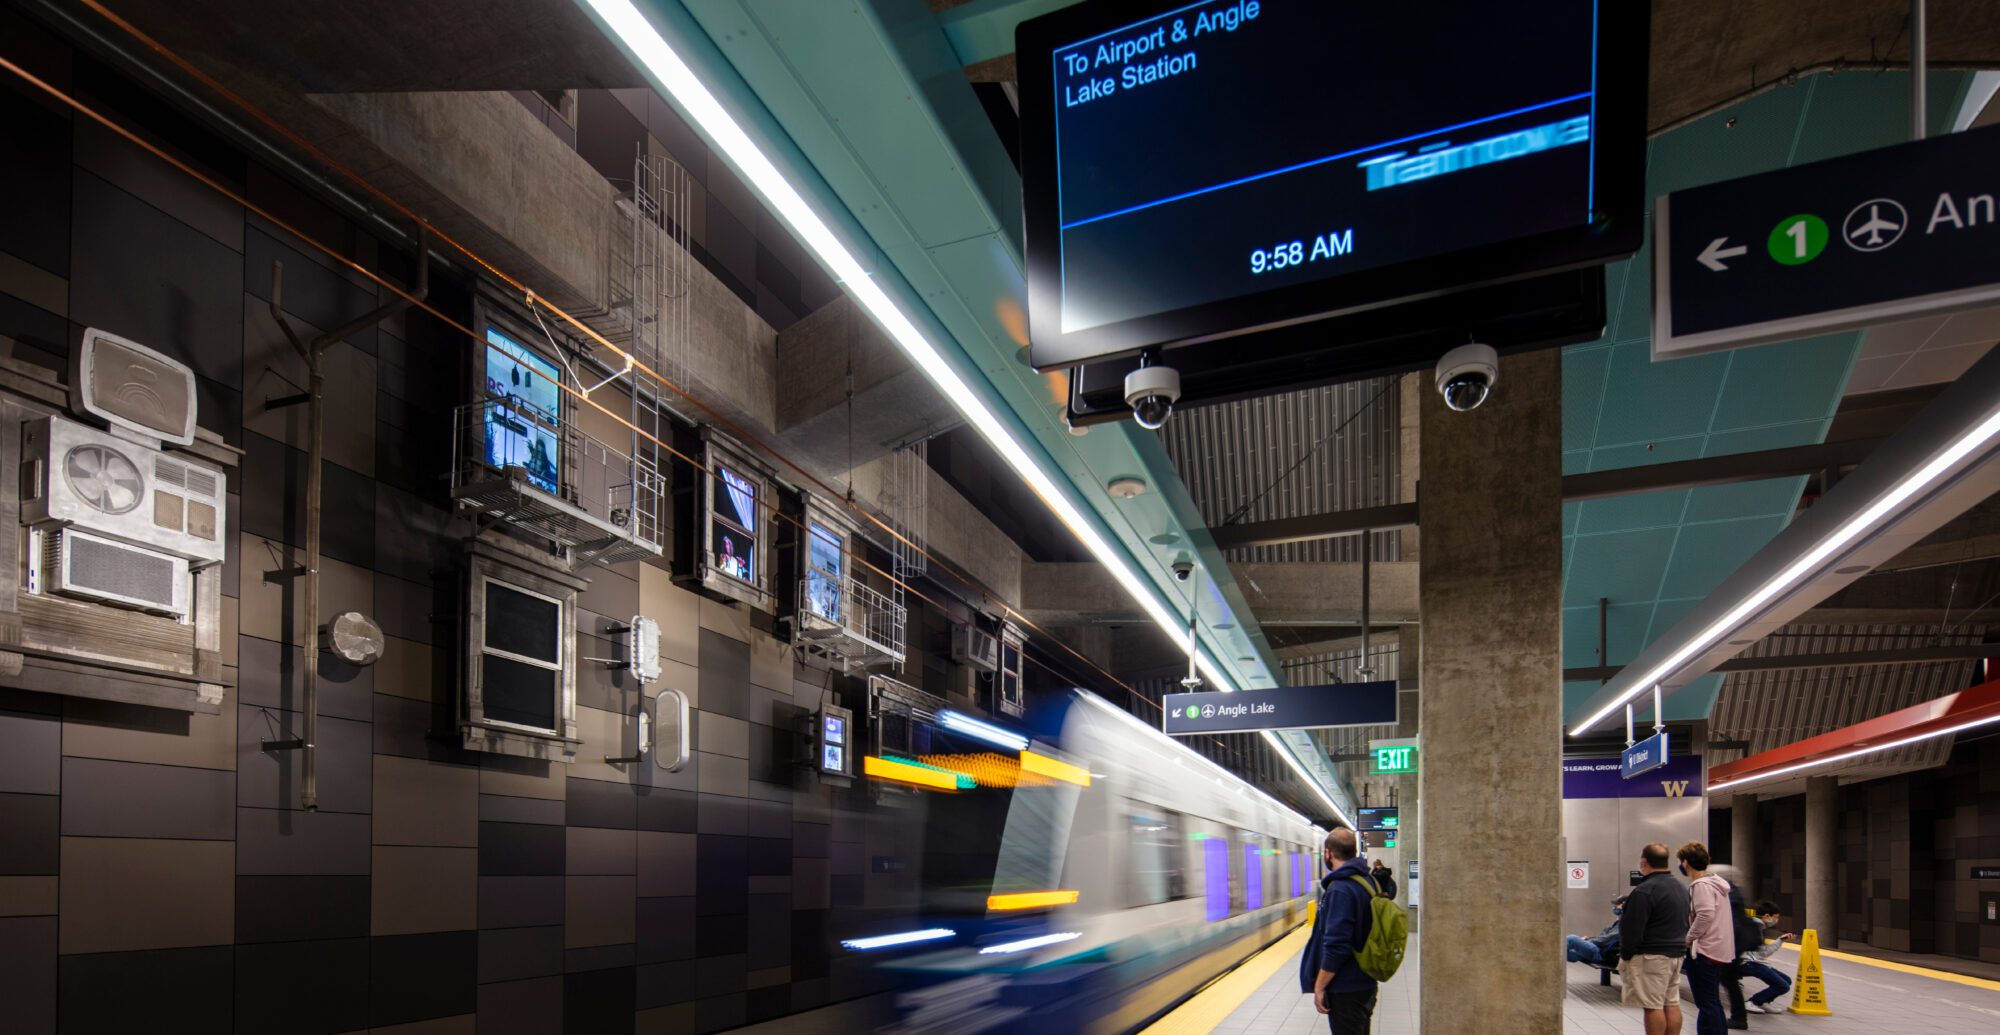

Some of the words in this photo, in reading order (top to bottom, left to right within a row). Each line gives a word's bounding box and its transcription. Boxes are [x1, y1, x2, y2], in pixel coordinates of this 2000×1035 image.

[1064, 53, 1089, 76] To
[1094, 26, 1166, 64] Airport
[1171, 18, 1188, 43] &
[1193, 0, 1261, 37] Angle
[1066, 78, 1116, 108] Lake
[1121, 51, 1197, 90] Station
[1251, 242, 1304, 274] 9:58
[1310, 229, 1353, 262] AM
[1786, 220, 1807, 258] 1
[1217, 703, 1247, 718] Angle
[1250, 702, 1275, 714] Lake
[1378, 747, 1411, 770] EXIT
[1661, 780, 1689, 797] W
